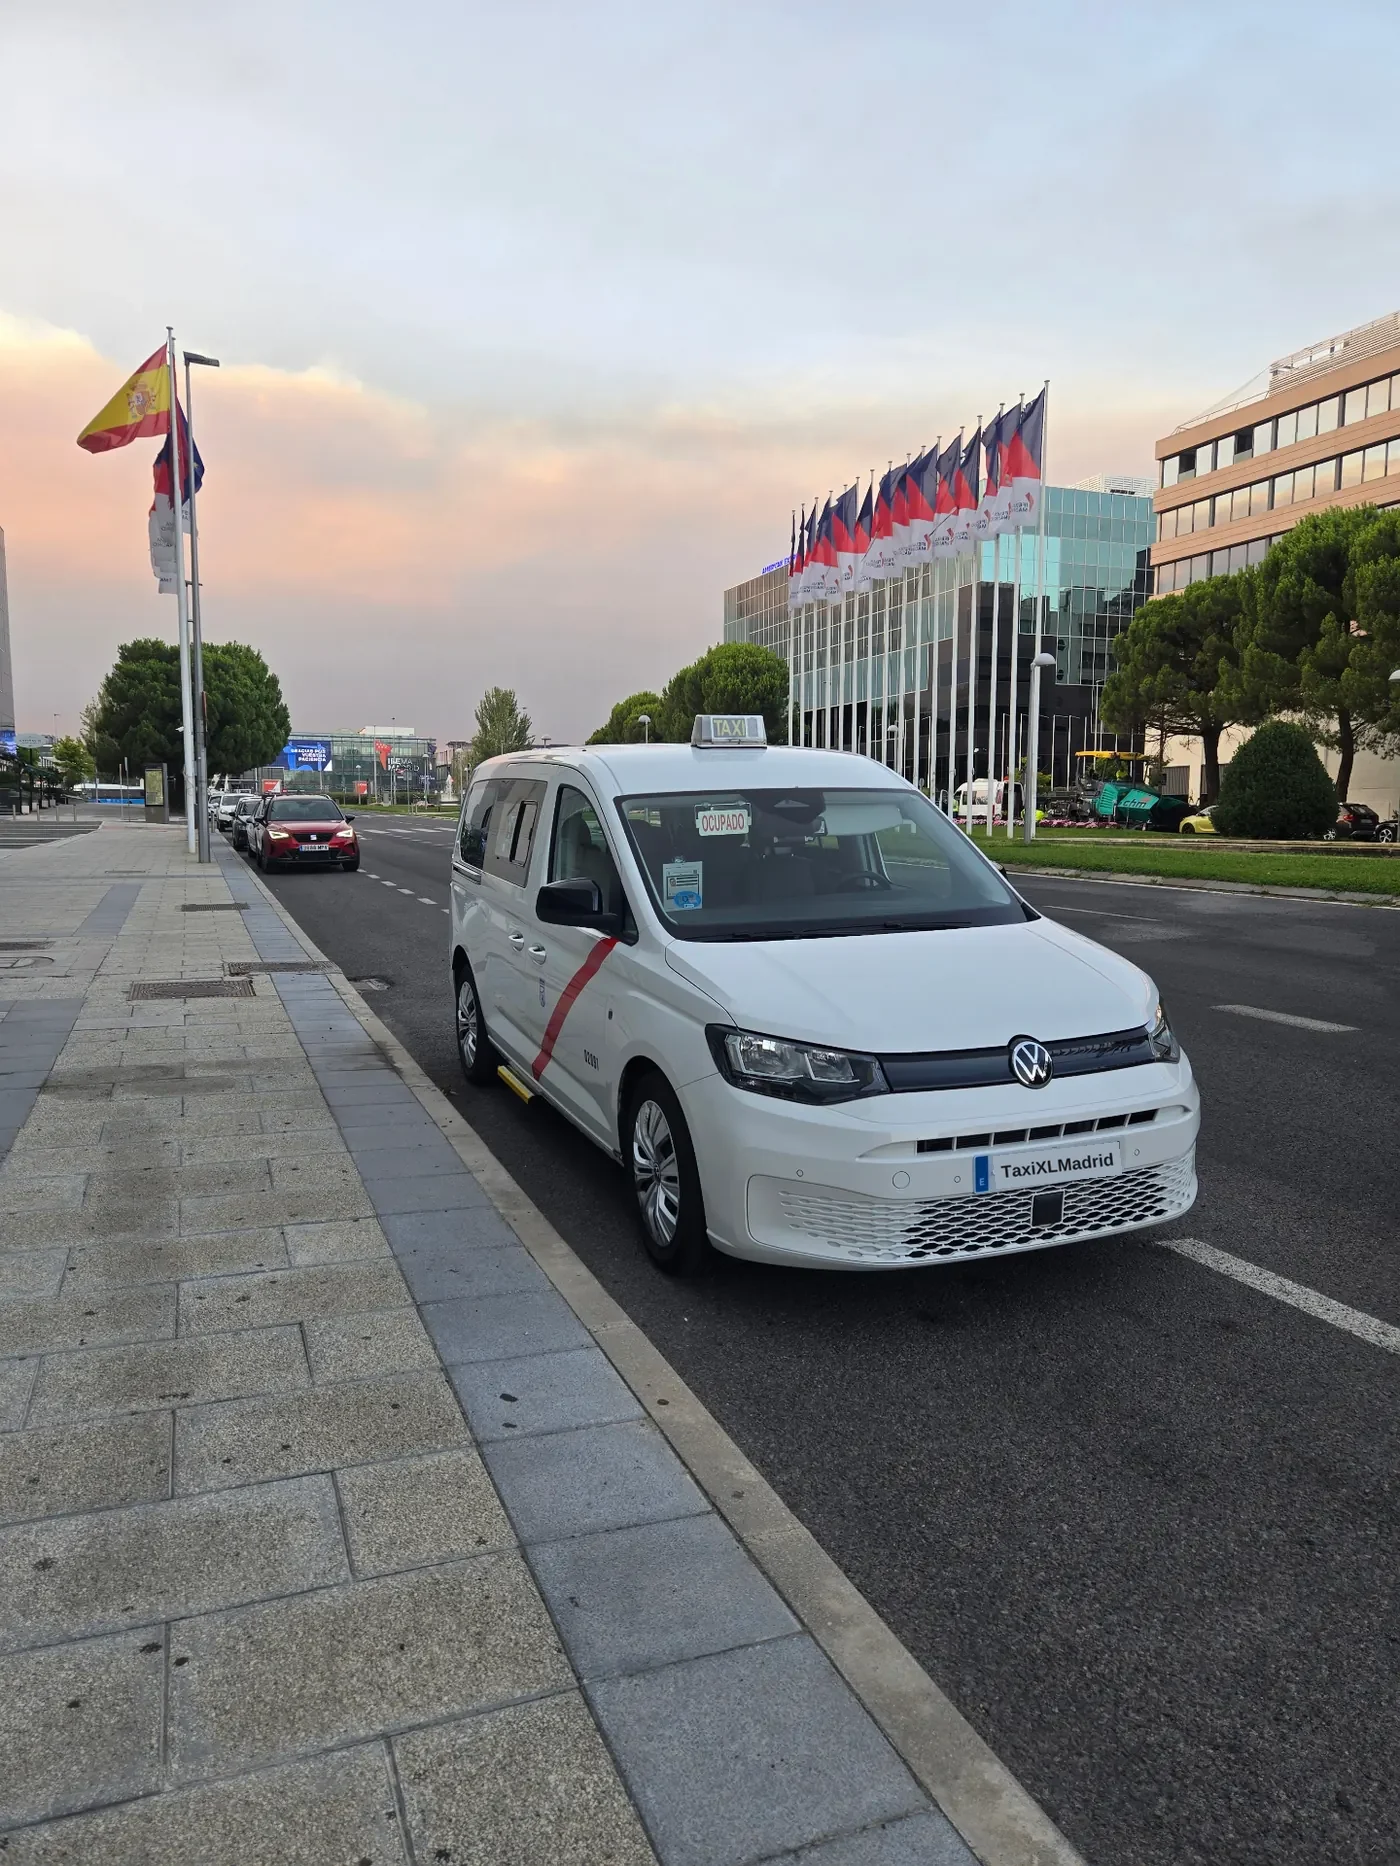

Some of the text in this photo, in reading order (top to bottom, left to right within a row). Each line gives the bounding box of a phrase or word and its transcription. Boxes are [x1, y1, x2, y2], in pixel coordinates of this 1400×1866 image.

[713, 719, 745, 736] TAXI
[702, 813, 745, 832] OCUPADO
[979, 1177, 986, 1186] E
